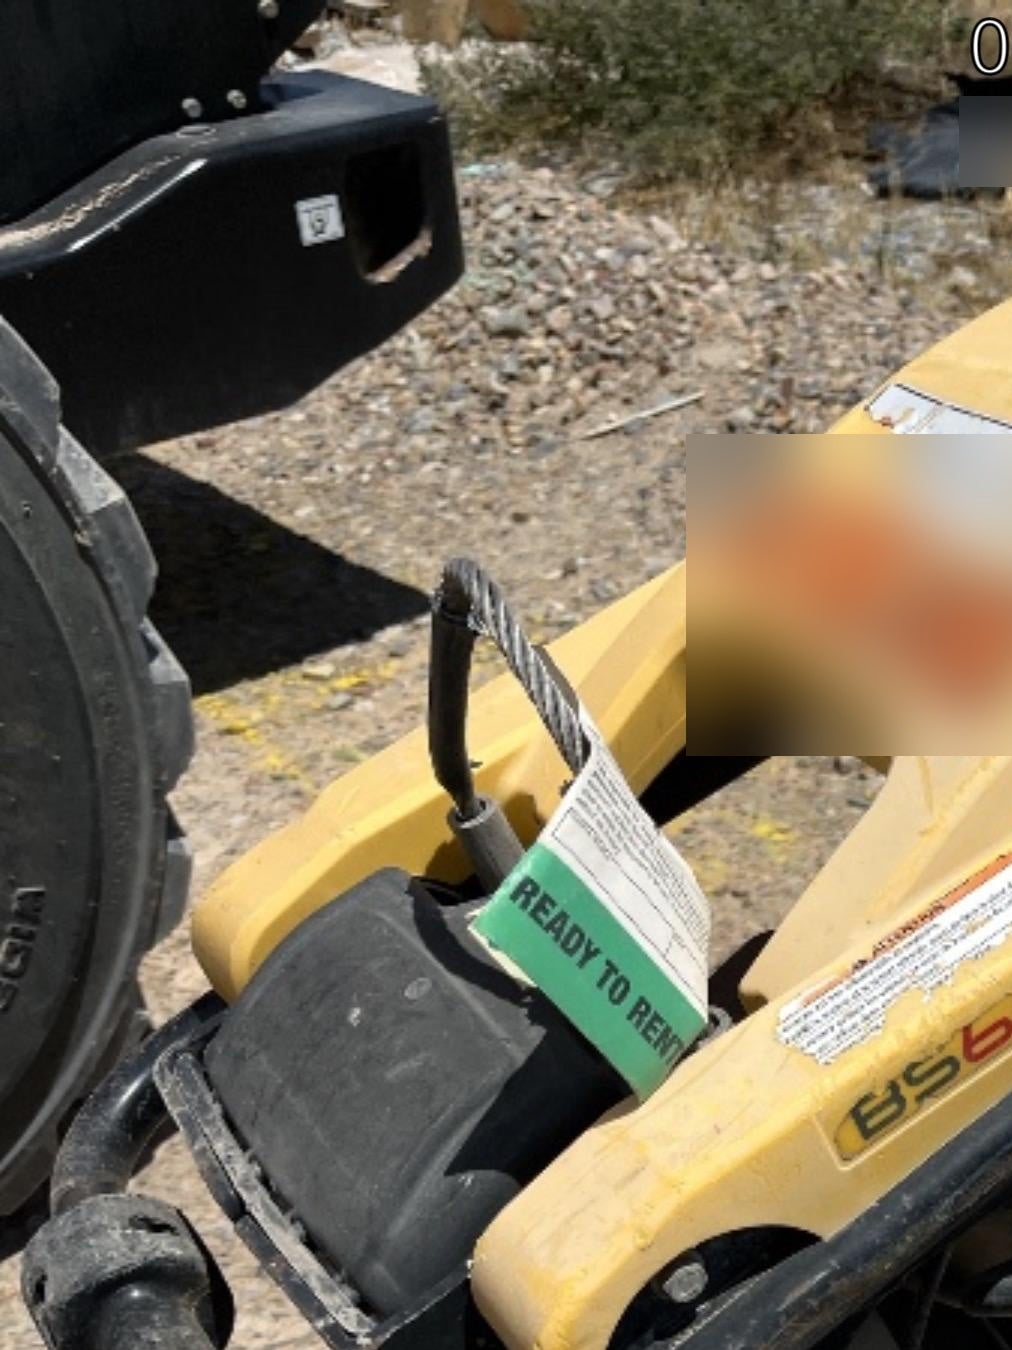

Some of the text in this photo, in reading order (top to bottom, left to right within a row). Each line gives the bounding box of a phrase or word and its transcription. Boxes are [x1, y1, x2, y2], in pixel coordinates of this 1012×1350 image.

[510, 875, 602, 969] READY
[596, 959, 631, 1006] TO
[626, 995, 686, 1067] RENT
